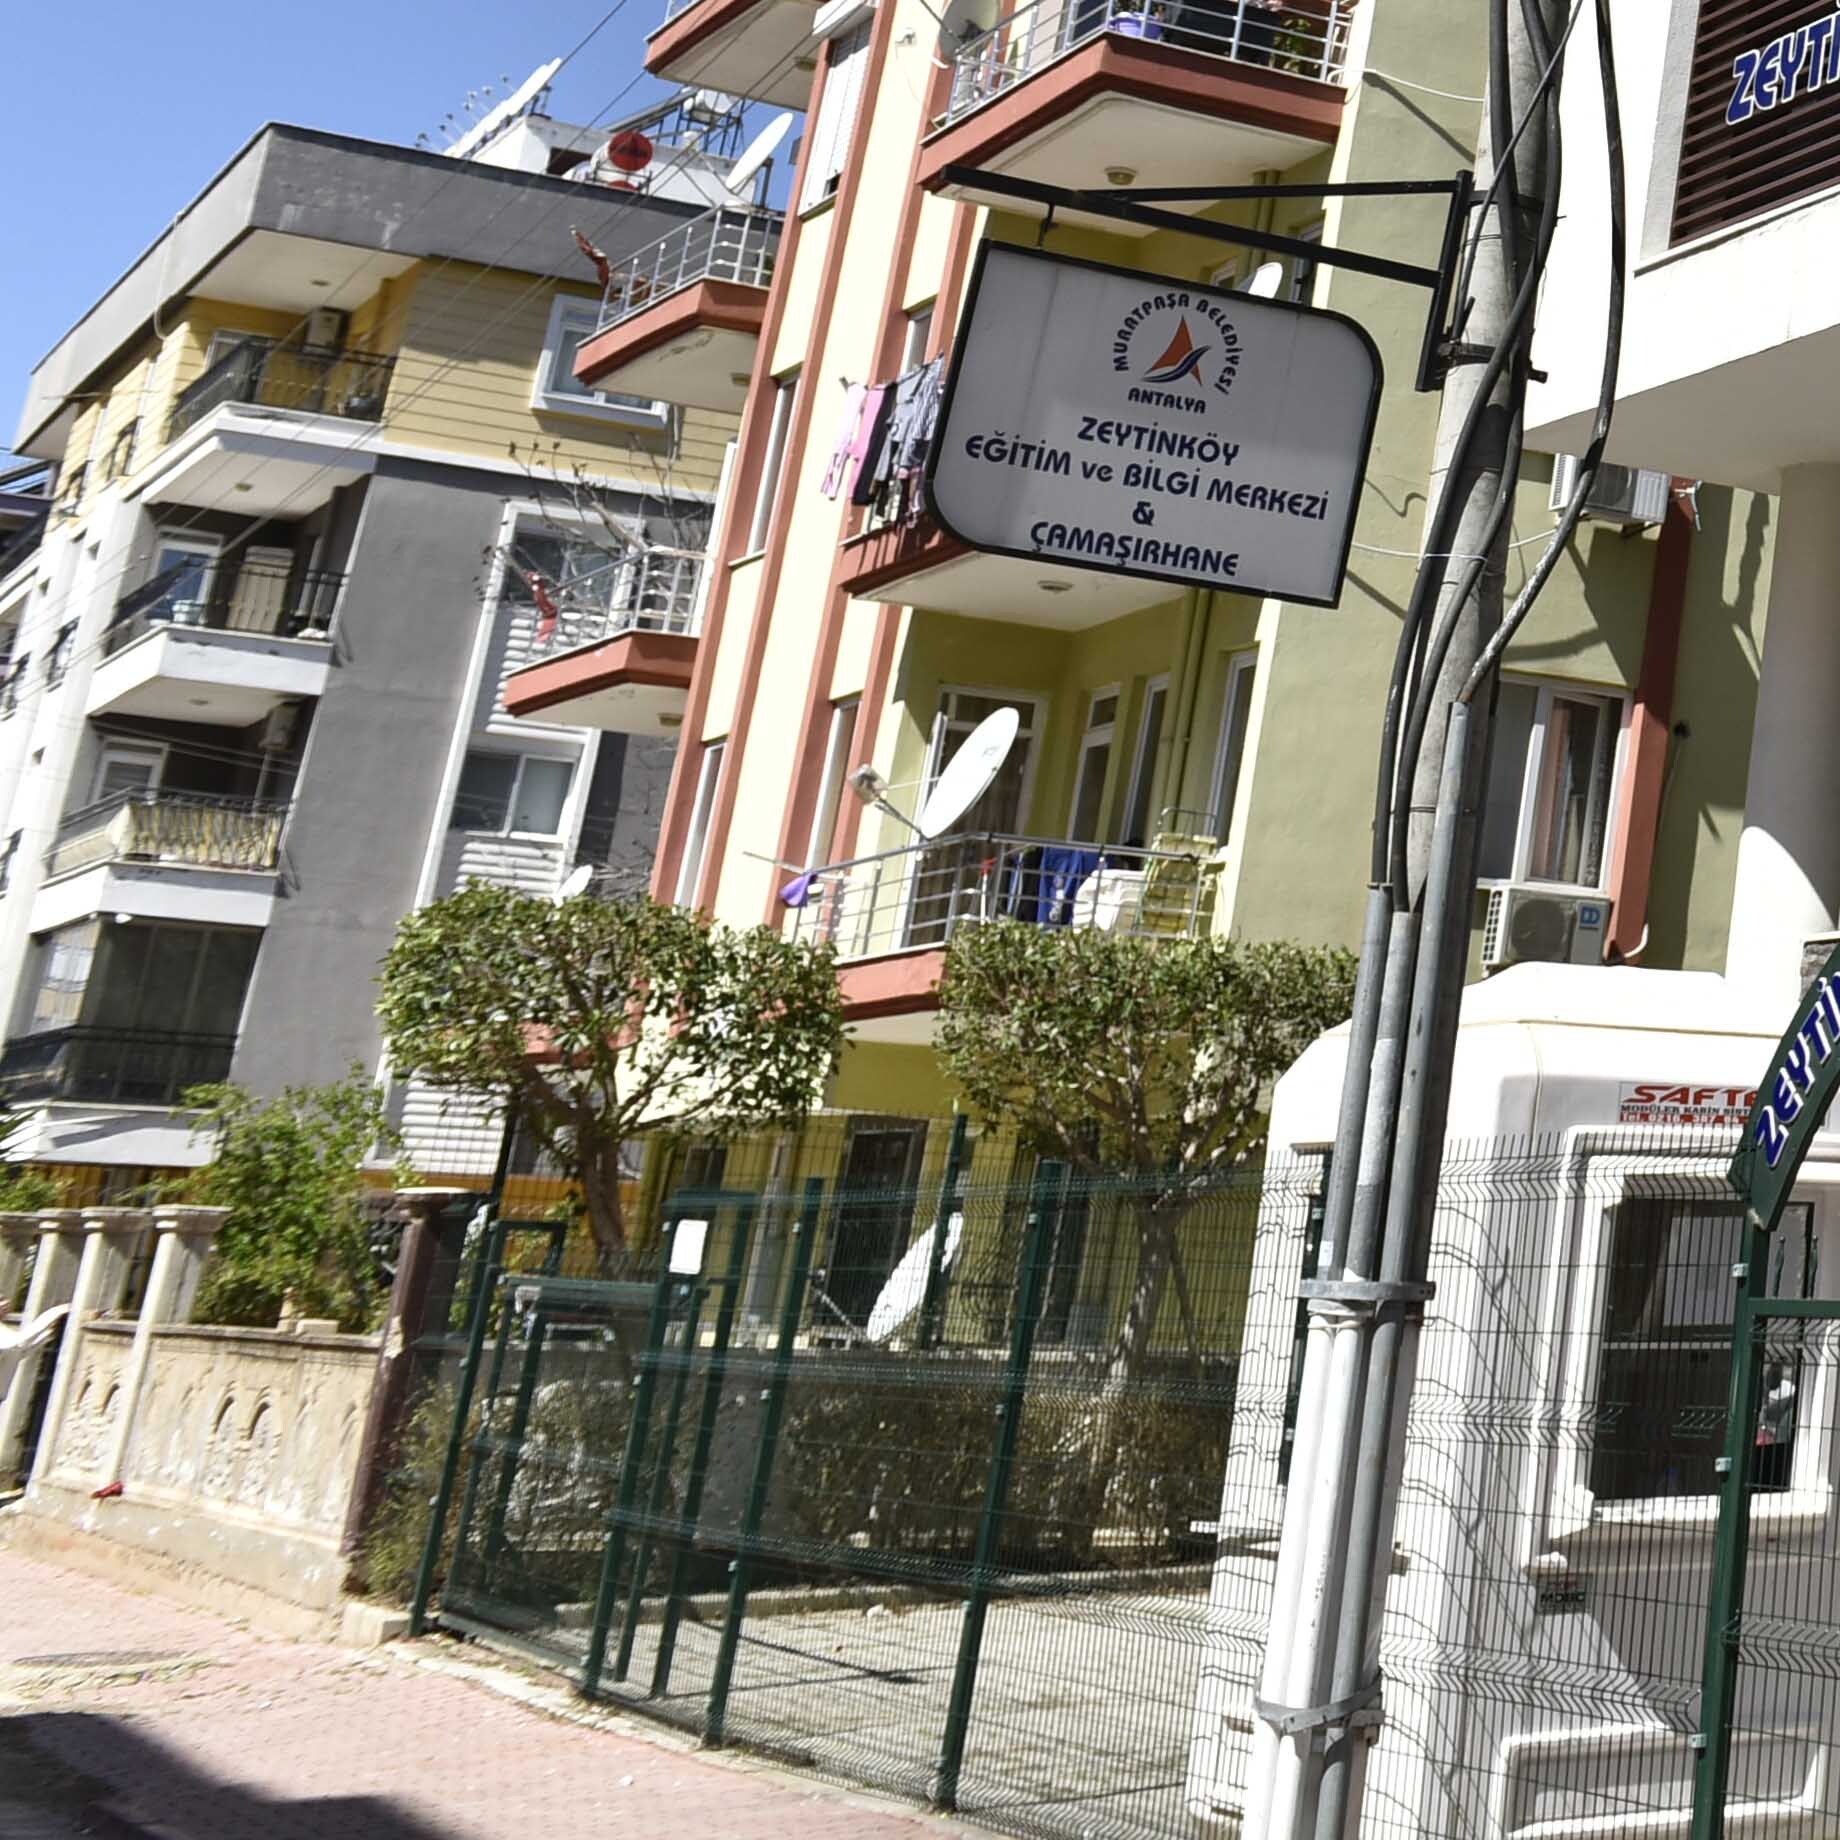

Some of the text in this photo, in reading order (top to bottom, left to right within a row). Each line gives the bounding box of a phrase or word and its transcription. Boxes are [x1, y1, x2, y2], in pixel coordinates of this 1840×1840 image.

[1113, 292, 1190, 372] MURATPAŞA
[1127, 387, 1207, 415] ANTALYA
[1077, 415, 1240, 467] ZEYTİNKÖY
[965, 431, 1330, 521] EĞİTİM ve BİLGİ MERKEZİ
[1131, 500, 1156, 527] &
[1030, 520, 1240, 578] ÇAMAŞIRHANE
